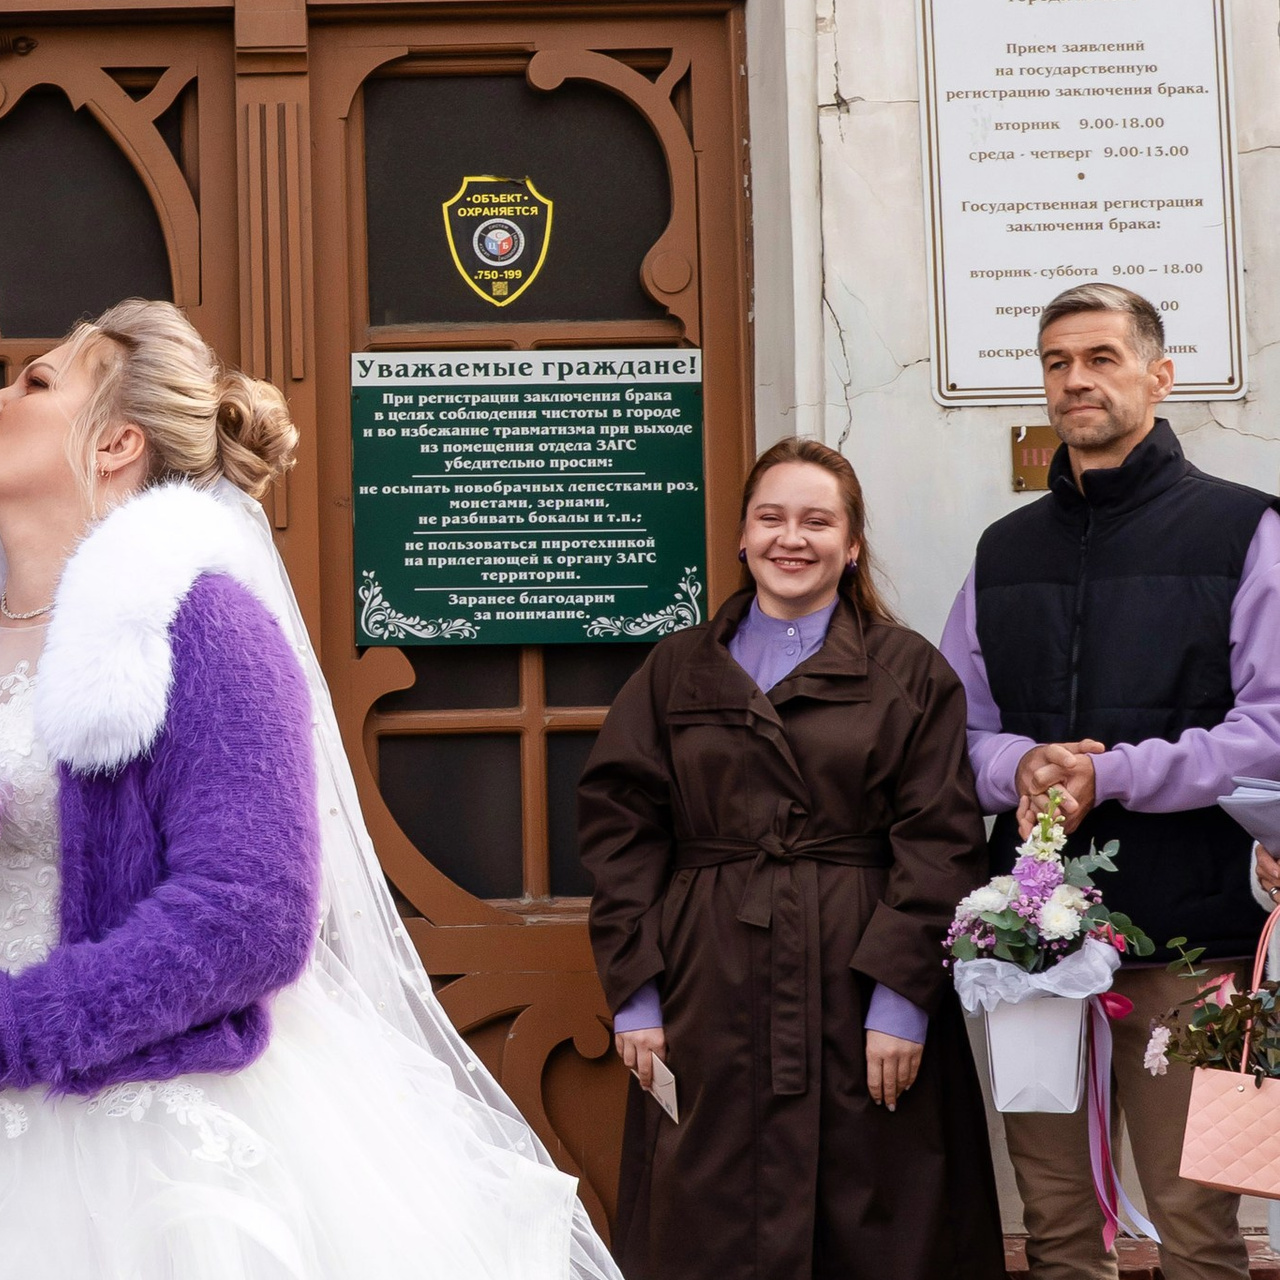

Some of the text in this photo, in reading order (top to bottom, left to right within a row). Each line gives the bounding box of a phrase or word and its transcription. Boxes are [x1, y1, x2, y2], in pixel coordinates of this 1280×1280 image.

[1007, 41, 1144, 56] Прием заявлений
[996, 65, 1157, 78] на государственную
[947, 83, 1208, 102] регистрацию заключения брака.
[995, 118, 1164, 133] вторник 9.00-18.00
[969, 151, 1014, 162] среда
[1031, 150, 1092, 161] четверг
[1104, 146, 1188, 157] 9.00-13.00
[472, 194, 522, 203] ОБЪЕКТ
[458, 207, 538, 216] ОХРАНЯЕТСЯ
[962, 199, 1203, 214] Государственная регистрация
[1007, 218, 1160, 232] заключения брака:
[1113, 265, 1144, 275] 9.00
[1164, 264, 1202, 273] 18.00
[996, 305, 1047, 317] перер
[979, 348, 1040, 360] воскрес
[357, 357, 696, 381] Уважаемые граждане!
[383, 389, 671, 406] При регистрации заключения брака
[375, 407, 680, 422] в целях соблюдения чистоты в городе
[364, 429, 372, 437] и
[401, 424, 489, 437] избежание
[493, 426, 595, 438] травматизма
[600, 426, 629, 437] при
[634, 425, 692, 435] выходе
[421, 440, 636, 453] из помещения отдела ЗАГС
[445, 456, 612, 472] убедительно просим:
[360, 481, 698, 495] не осыпать новобрачных лепестками роз,
[450, 499, 609, 510] монетами, зернами,
[419, 516, 437, 524] не
[442, 512, 524, 527] разбивать
[529, 511, 588, 523] бокалы
[607, 514, 641, 522] т.п.;
[406, 537, 654, 551] не пользоваться пиротехникой
[428, 554, 538, 568] прилегающей
[544, 556, 553, 564] к
[557, 556, 612, 566] органу
[617, 553, 656, 563] ЗАГС
[481, 572, 580, 583] территории.
[449, 592, 614, 607] Заранее благодарим
[474, 611, 590, 620] за понимание.
